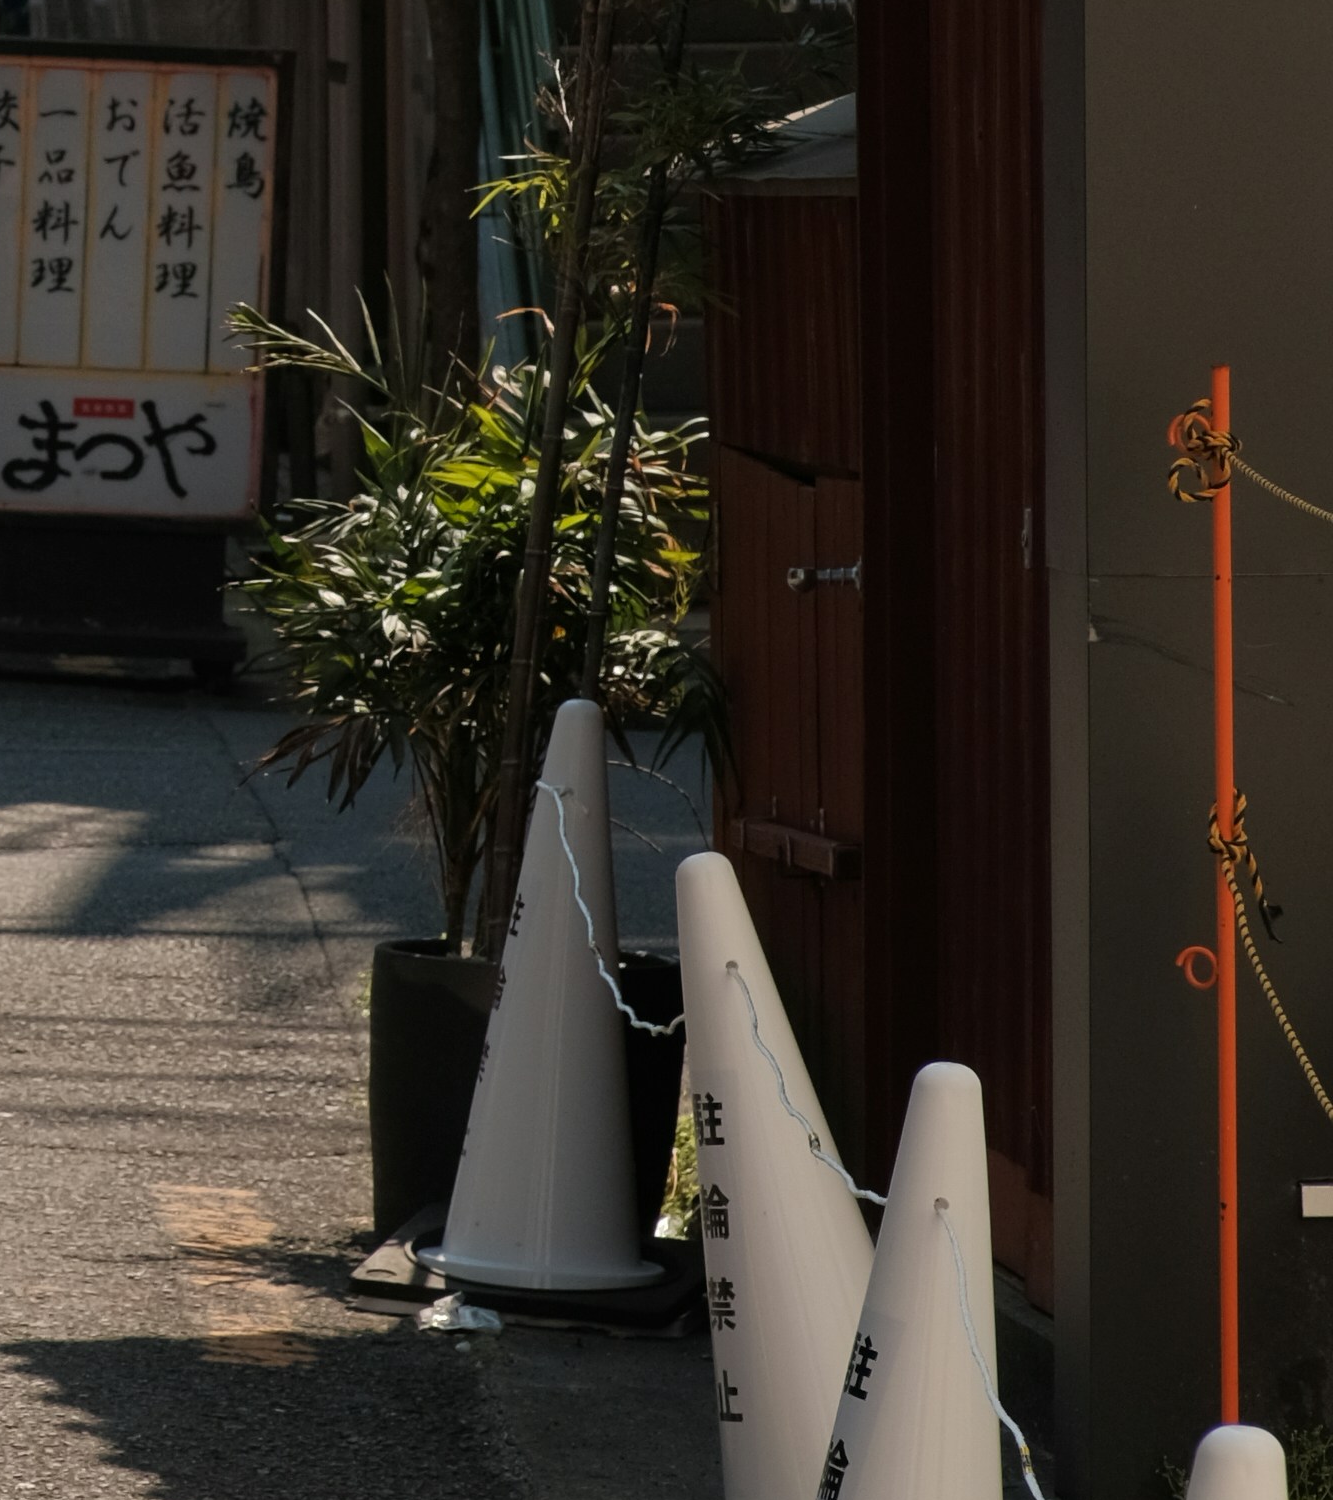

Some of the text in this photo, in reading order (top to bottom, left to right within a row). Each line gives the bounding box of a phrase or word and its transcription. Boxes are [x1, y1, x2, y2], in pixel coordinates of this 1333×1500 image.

[30, 107, 79, 295] 一品料理
[100, 97, 140, 242] おでん
[154, 97, 206, 299] 活魚料理
[224, 98, 269, 199] 焼鳥
[2, 401, 217, 498] まつや
